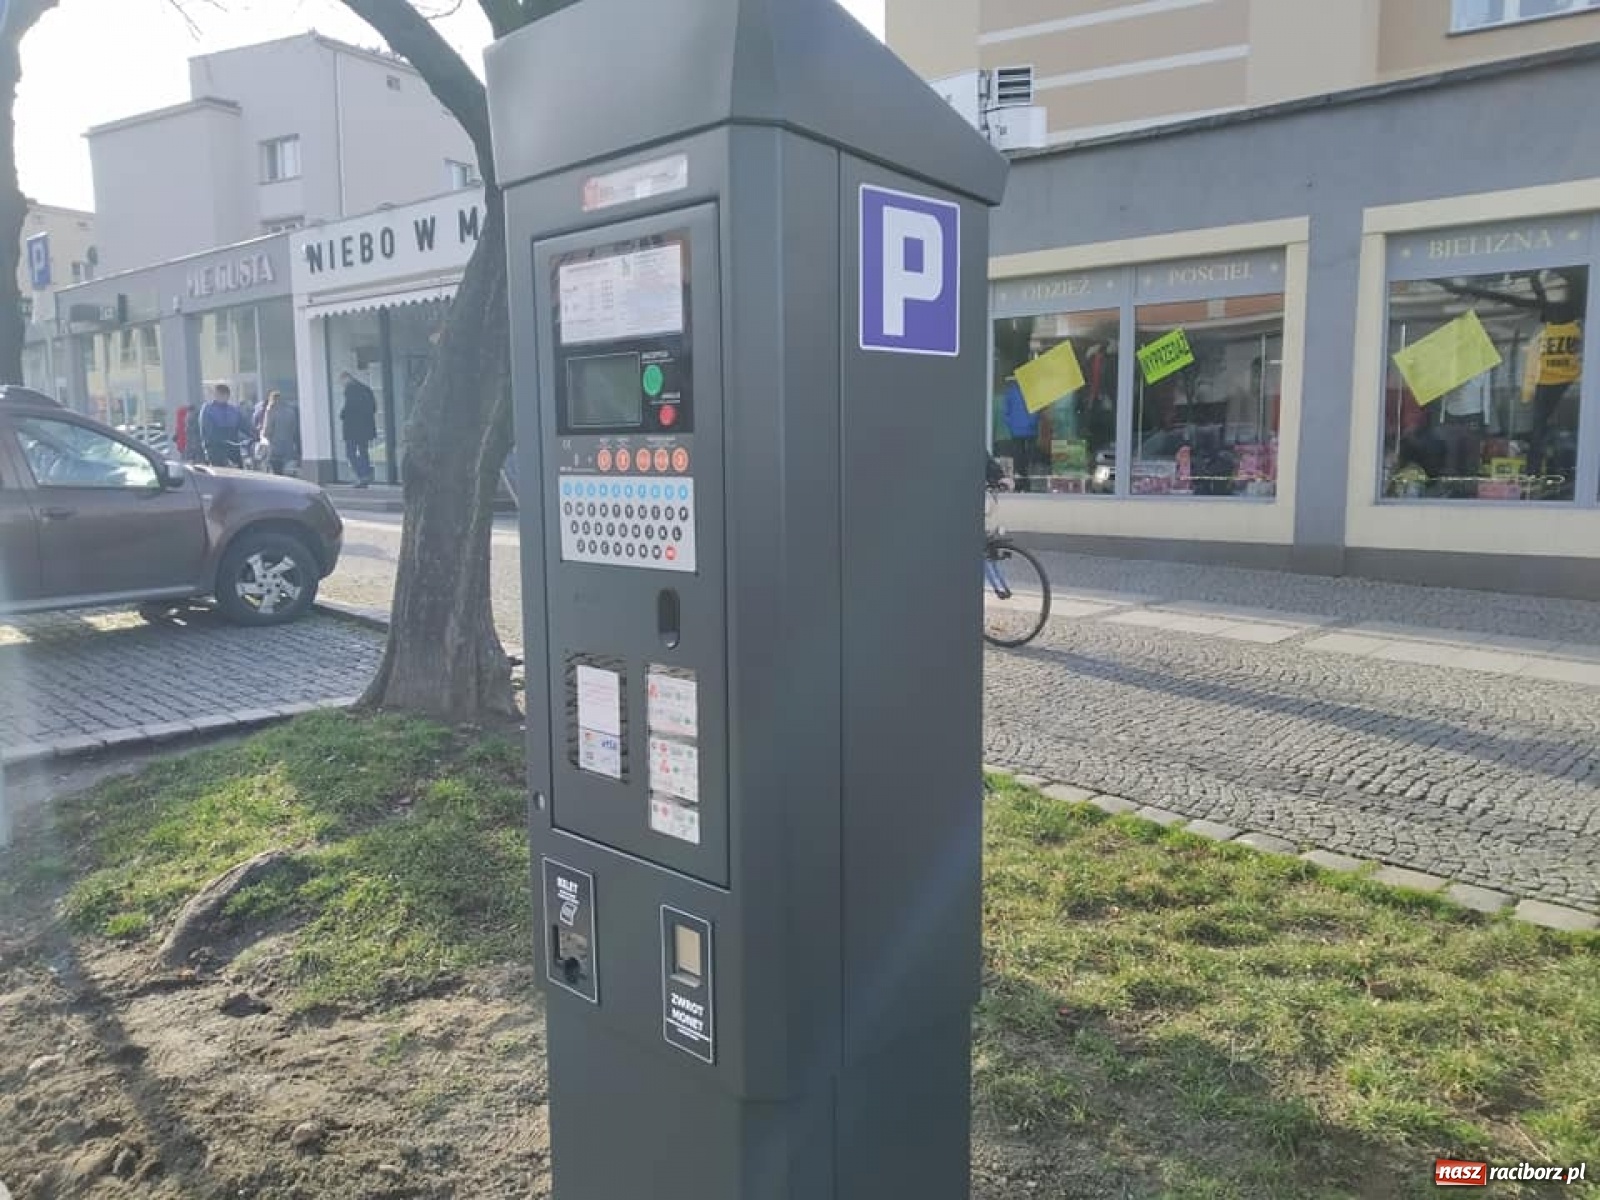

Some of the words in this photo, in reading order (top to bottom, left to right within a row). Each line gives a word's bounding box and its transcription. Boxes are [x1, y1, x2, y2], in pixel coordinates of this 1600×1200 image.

[305, 226, 395, 274] NIEBO
[413, 214, 436, 252] W
[458, 205, 479, 243] M
[882, 205, 944, 336] P
